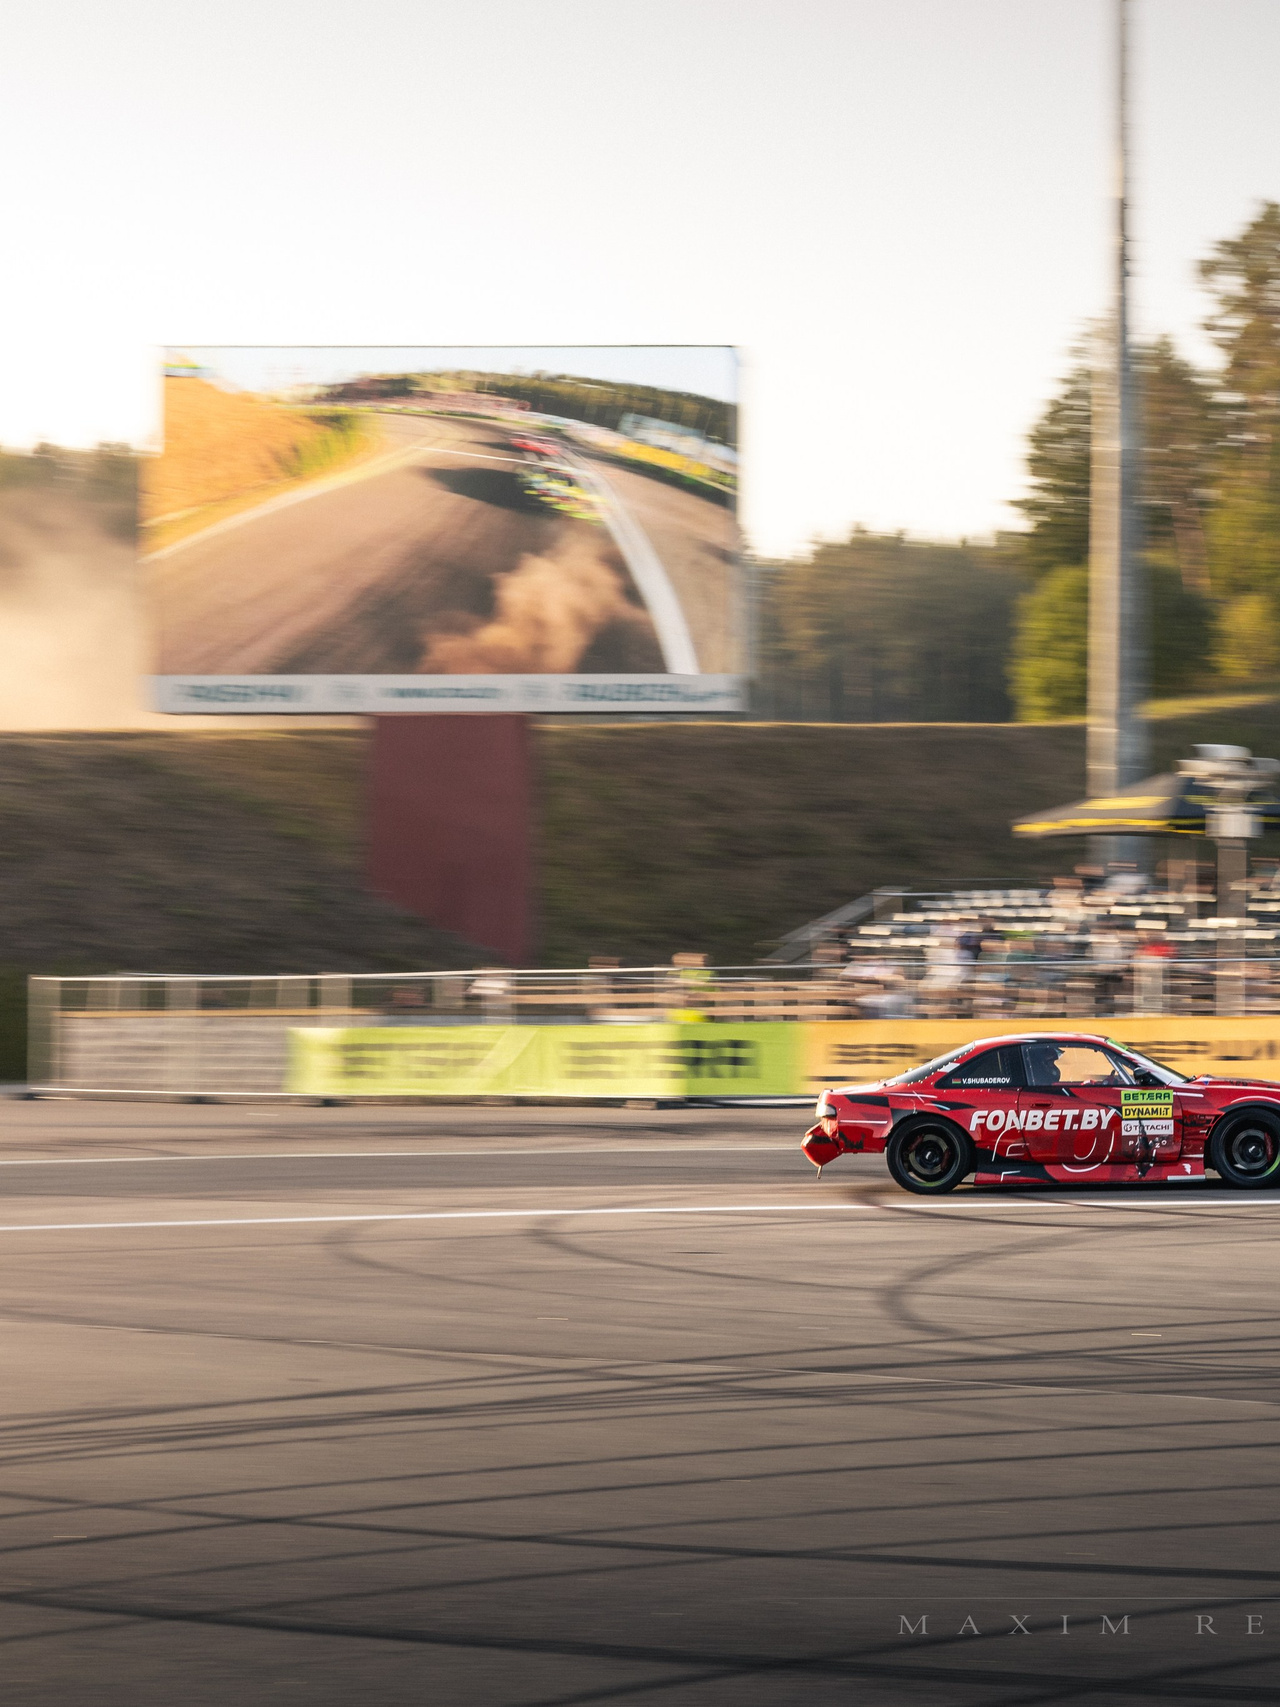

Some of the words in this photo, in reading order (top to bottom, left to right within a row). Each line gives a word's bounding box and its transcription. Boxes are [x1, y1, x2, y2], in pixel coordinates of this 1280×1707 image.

[962, 1077, 1011, 1085] V.SHUBADEROV
[1123, 1092, 1171, 1101] BETERA
[969, 1108, 1117, 1132] FONBET.BY
